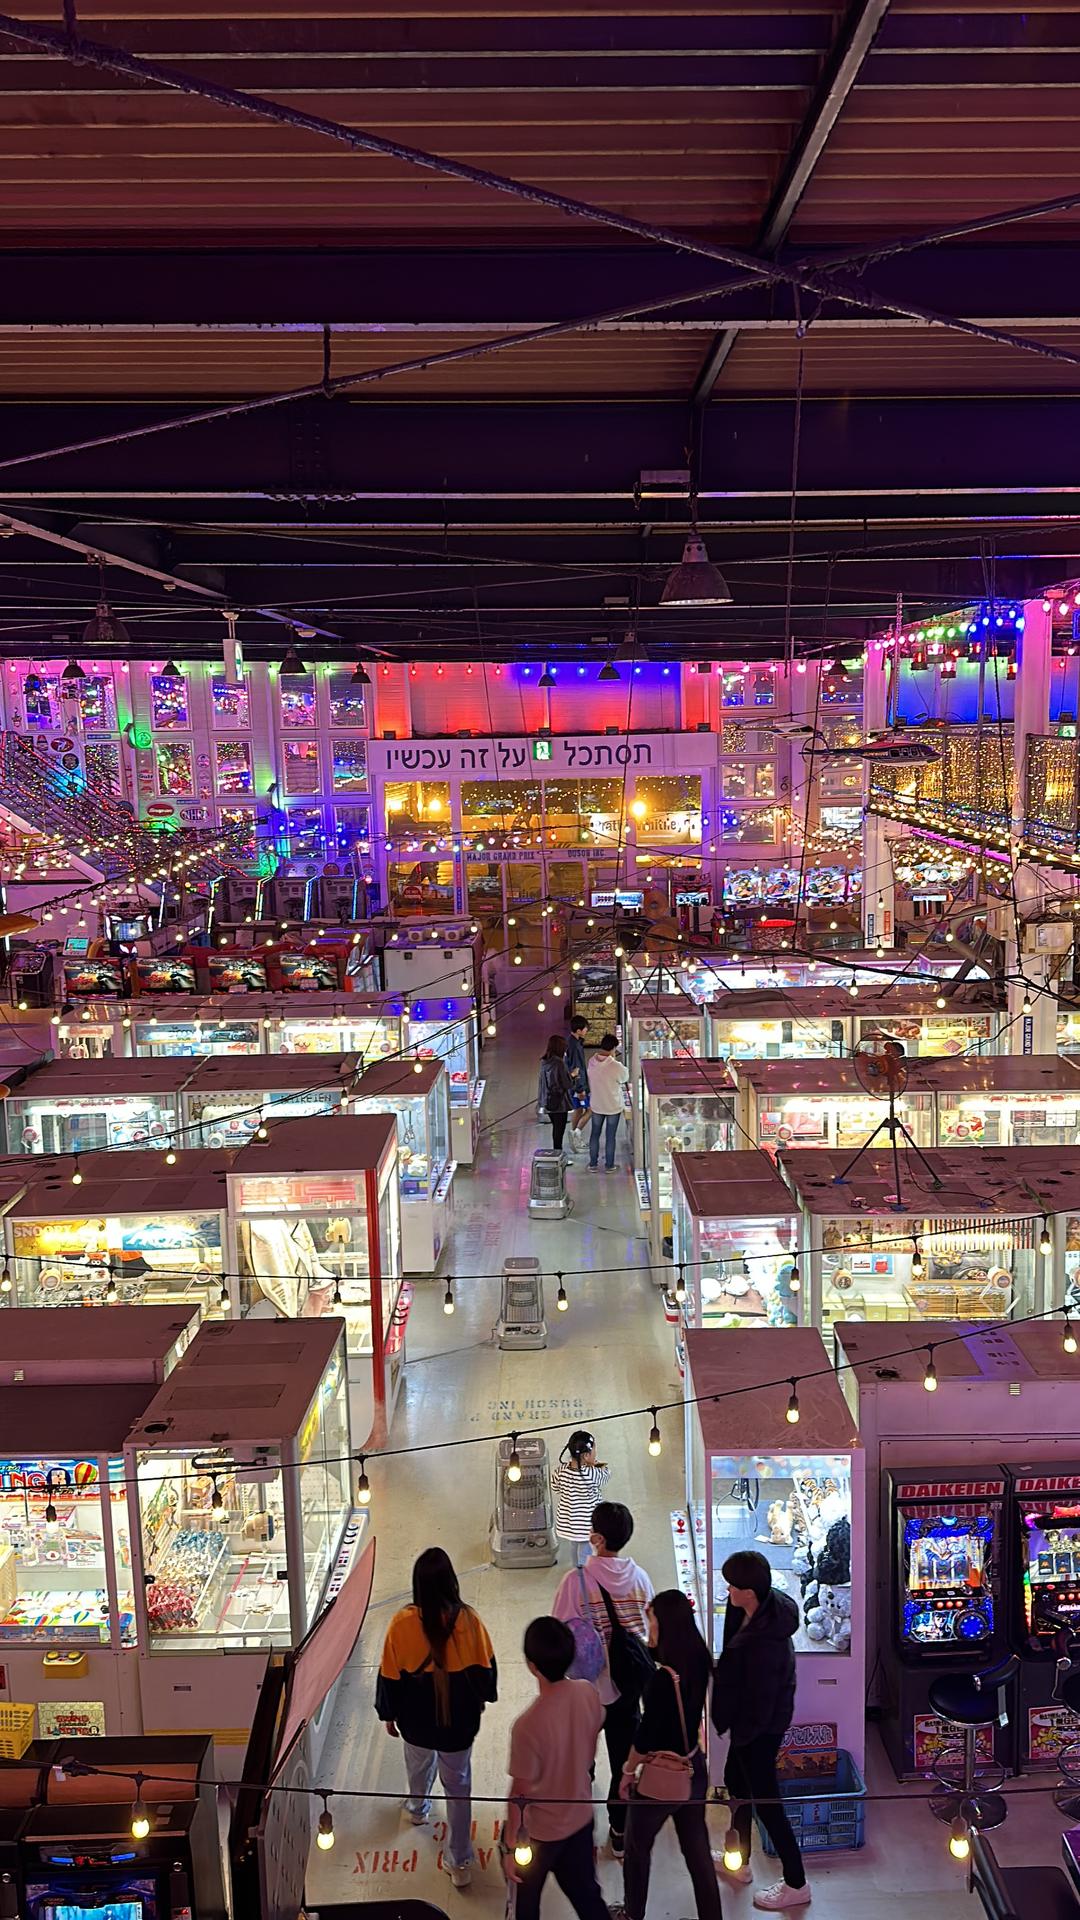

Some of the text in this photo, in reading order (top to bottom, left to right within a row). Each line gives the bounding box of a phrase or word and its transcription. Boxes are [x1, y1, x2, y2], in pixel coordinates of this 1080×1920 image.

[387, 741, 652, 769] תסתכל על זה עכשיו
[467, 851, 535, 861] MAJOR GRAND PRIX
[902, 1481, 1000, 1498] DAIKEIEN
[1019, 1476, 1080, 1491] DAIKE
[353, 1849, 418, 1873] PRIX
